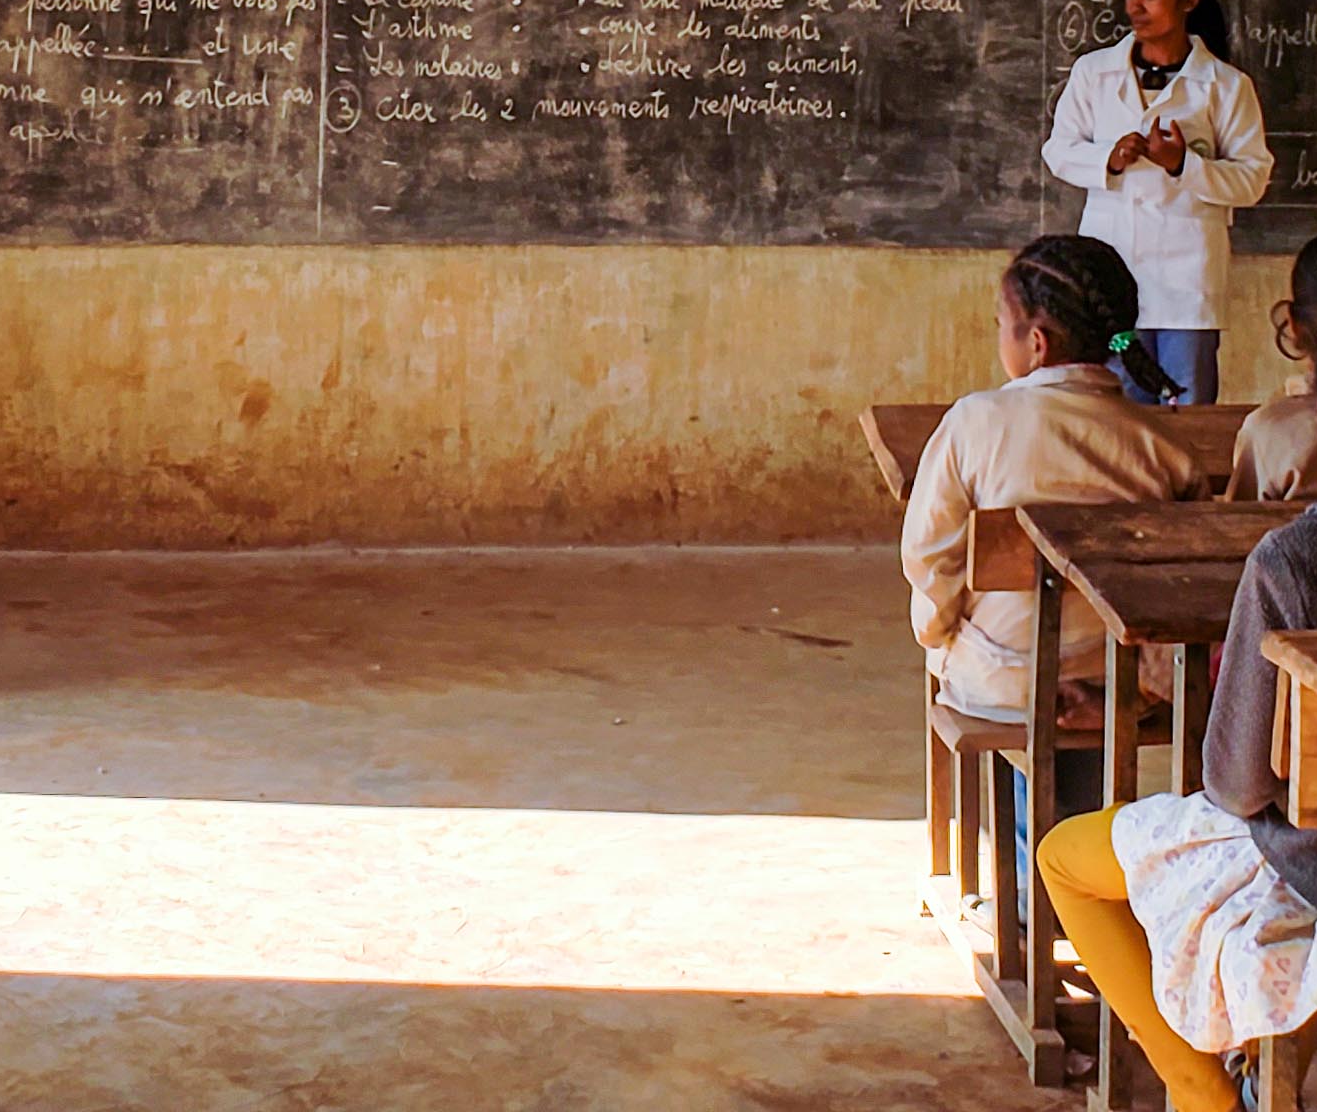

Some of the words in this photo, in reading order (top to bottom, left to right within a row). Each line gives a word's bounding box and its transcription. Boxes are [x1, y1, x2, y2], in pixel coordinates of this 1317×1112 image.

[203, 18, 228, 56] et
[242, 32, 295, 61] une
[599, 15, 657, 54] coupe
[677, 10, 711, 39] les
[724, 14, 821, 40] aliments
[415, 45, 502, 80] molaires
[708, 43, 746, 77] les
[81, 80, 126, 120] qui
[139, 73, 270, 110] n'entend
[282, 86, 314, 119] pas
[450, 92, 487, 121] les
[501, 99, 516, 120] 2
[532, 89, 670, 121] mouvements
